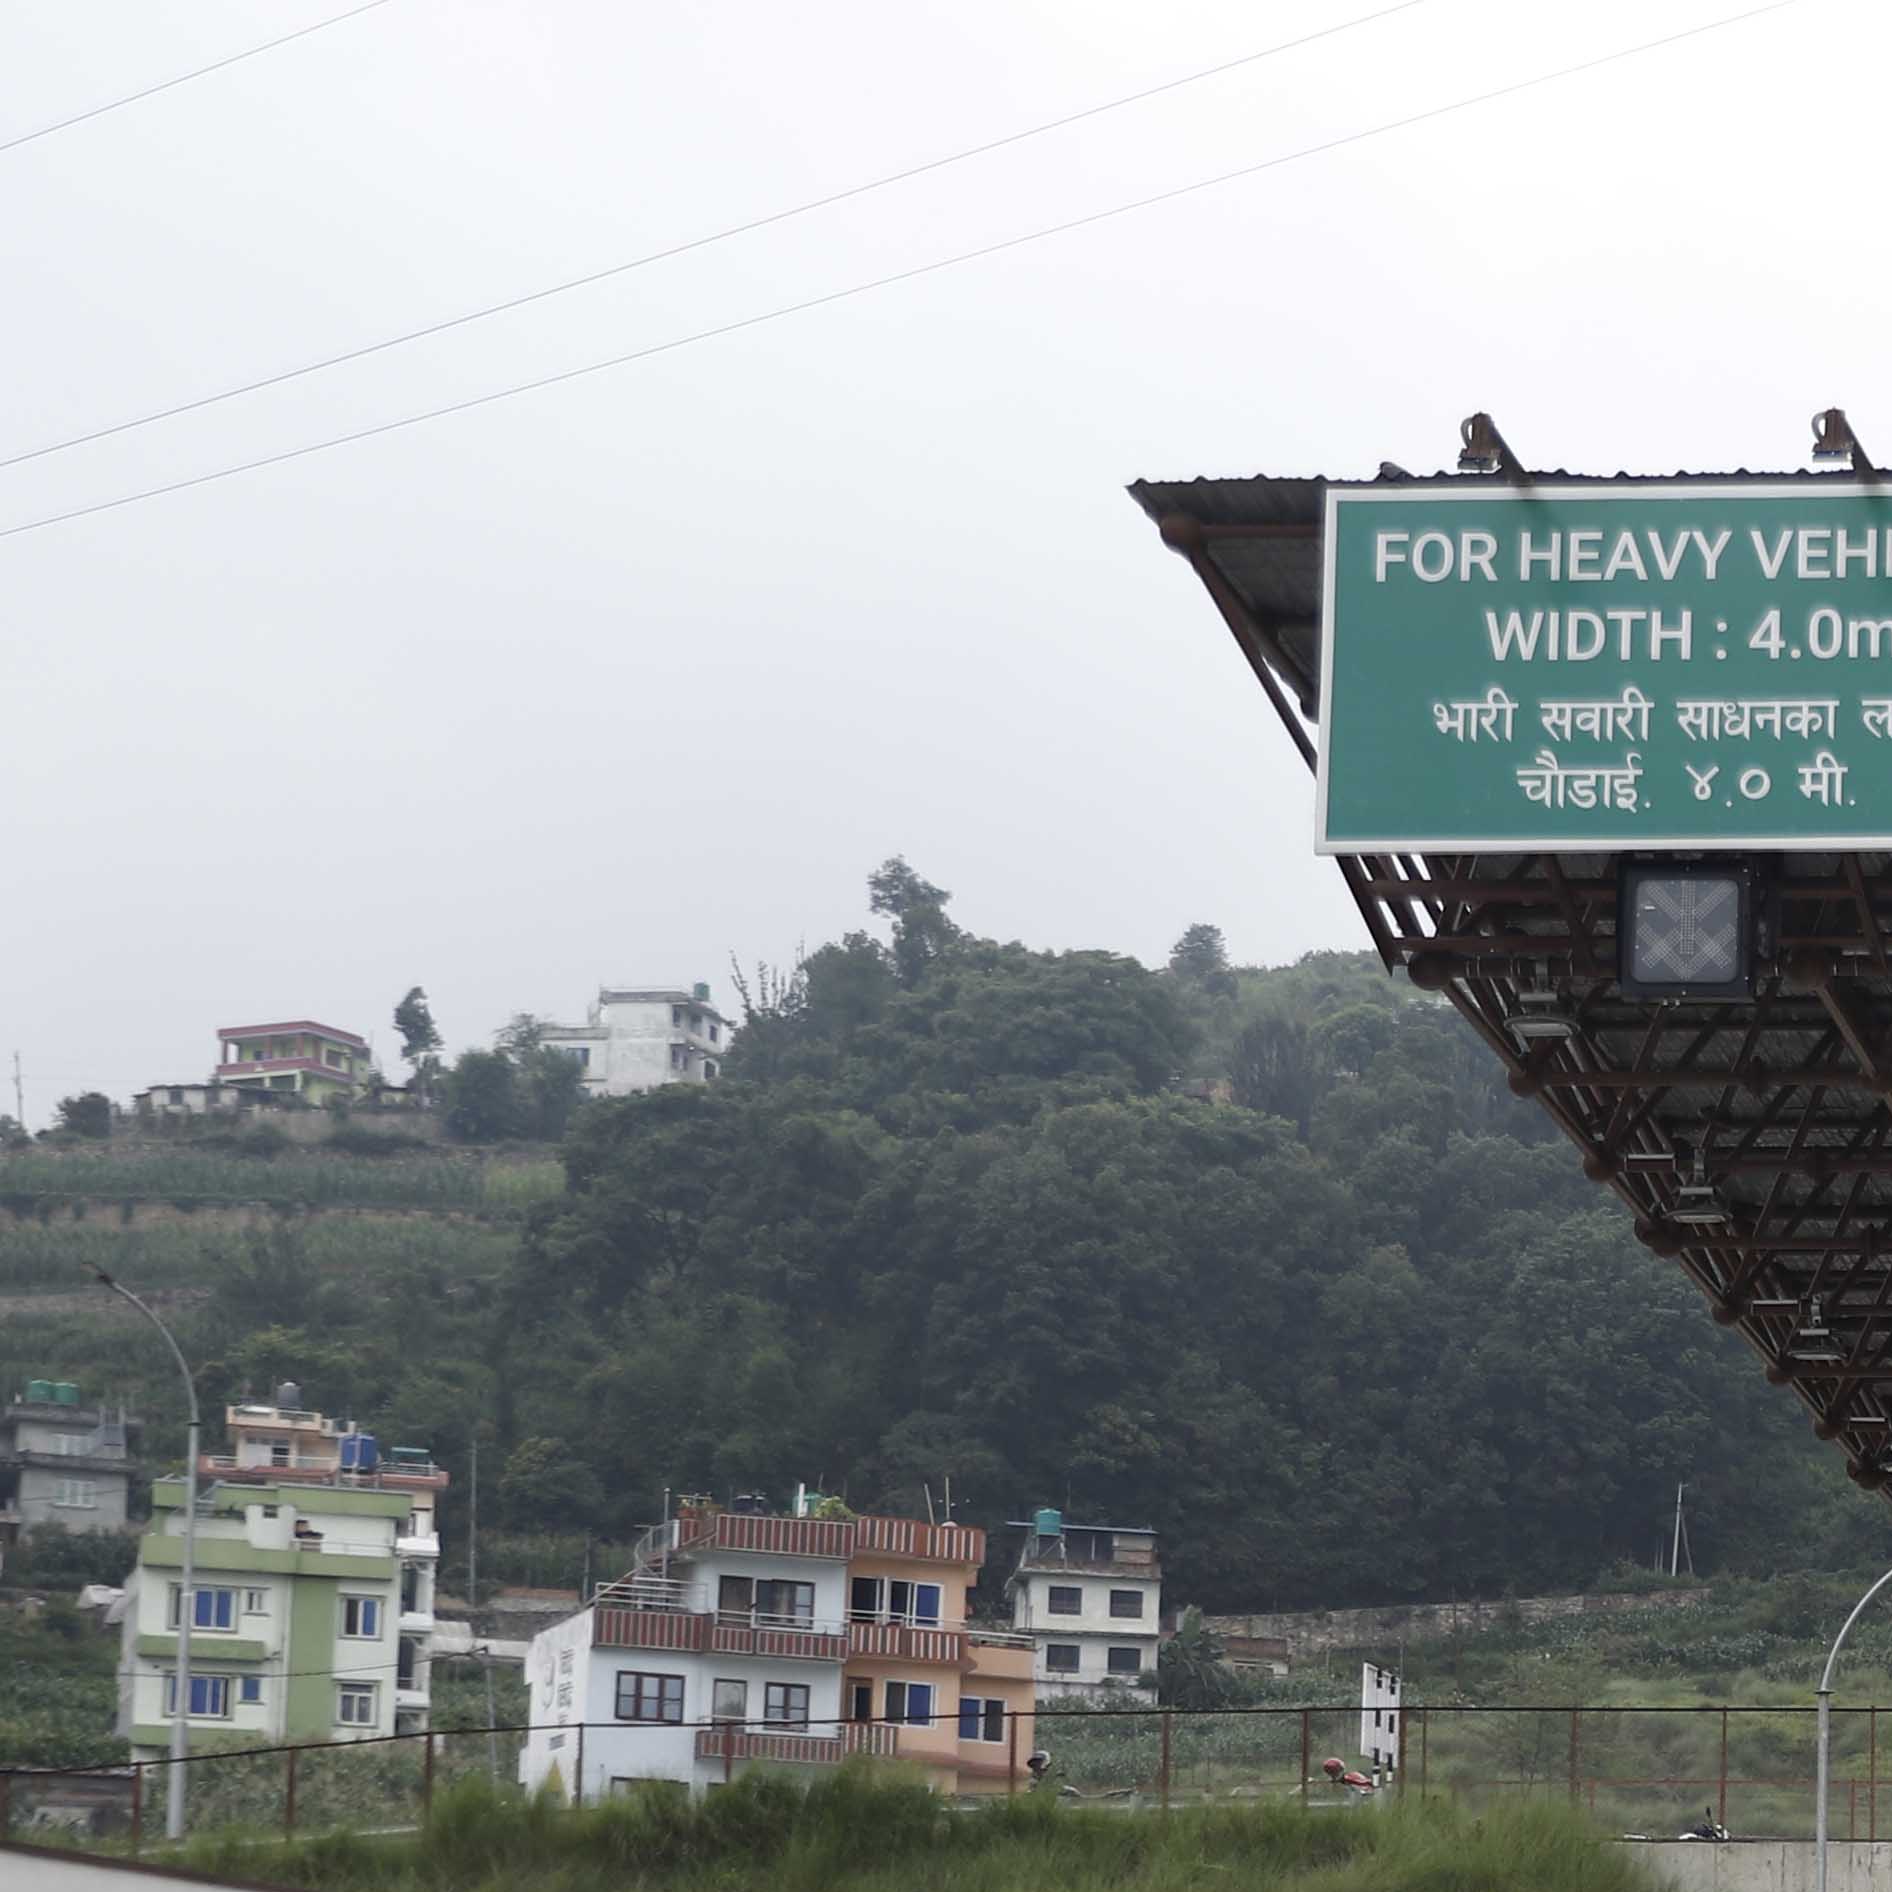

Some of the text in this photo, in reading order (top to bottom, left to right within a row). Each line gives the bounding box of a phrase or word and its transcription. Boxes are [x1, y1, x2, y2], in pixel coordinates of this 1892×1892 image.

[1375, 531, 1497, 583] FOR
[1519, 529, 1732, 581] HEAVY
[1486, 609, 1692, 662] WIDTH
[1432, 686, 1519, 742] भारी
[1539, 685, 1655, 742] सवारी
[1675, 697, 1840, 742] साधनका
